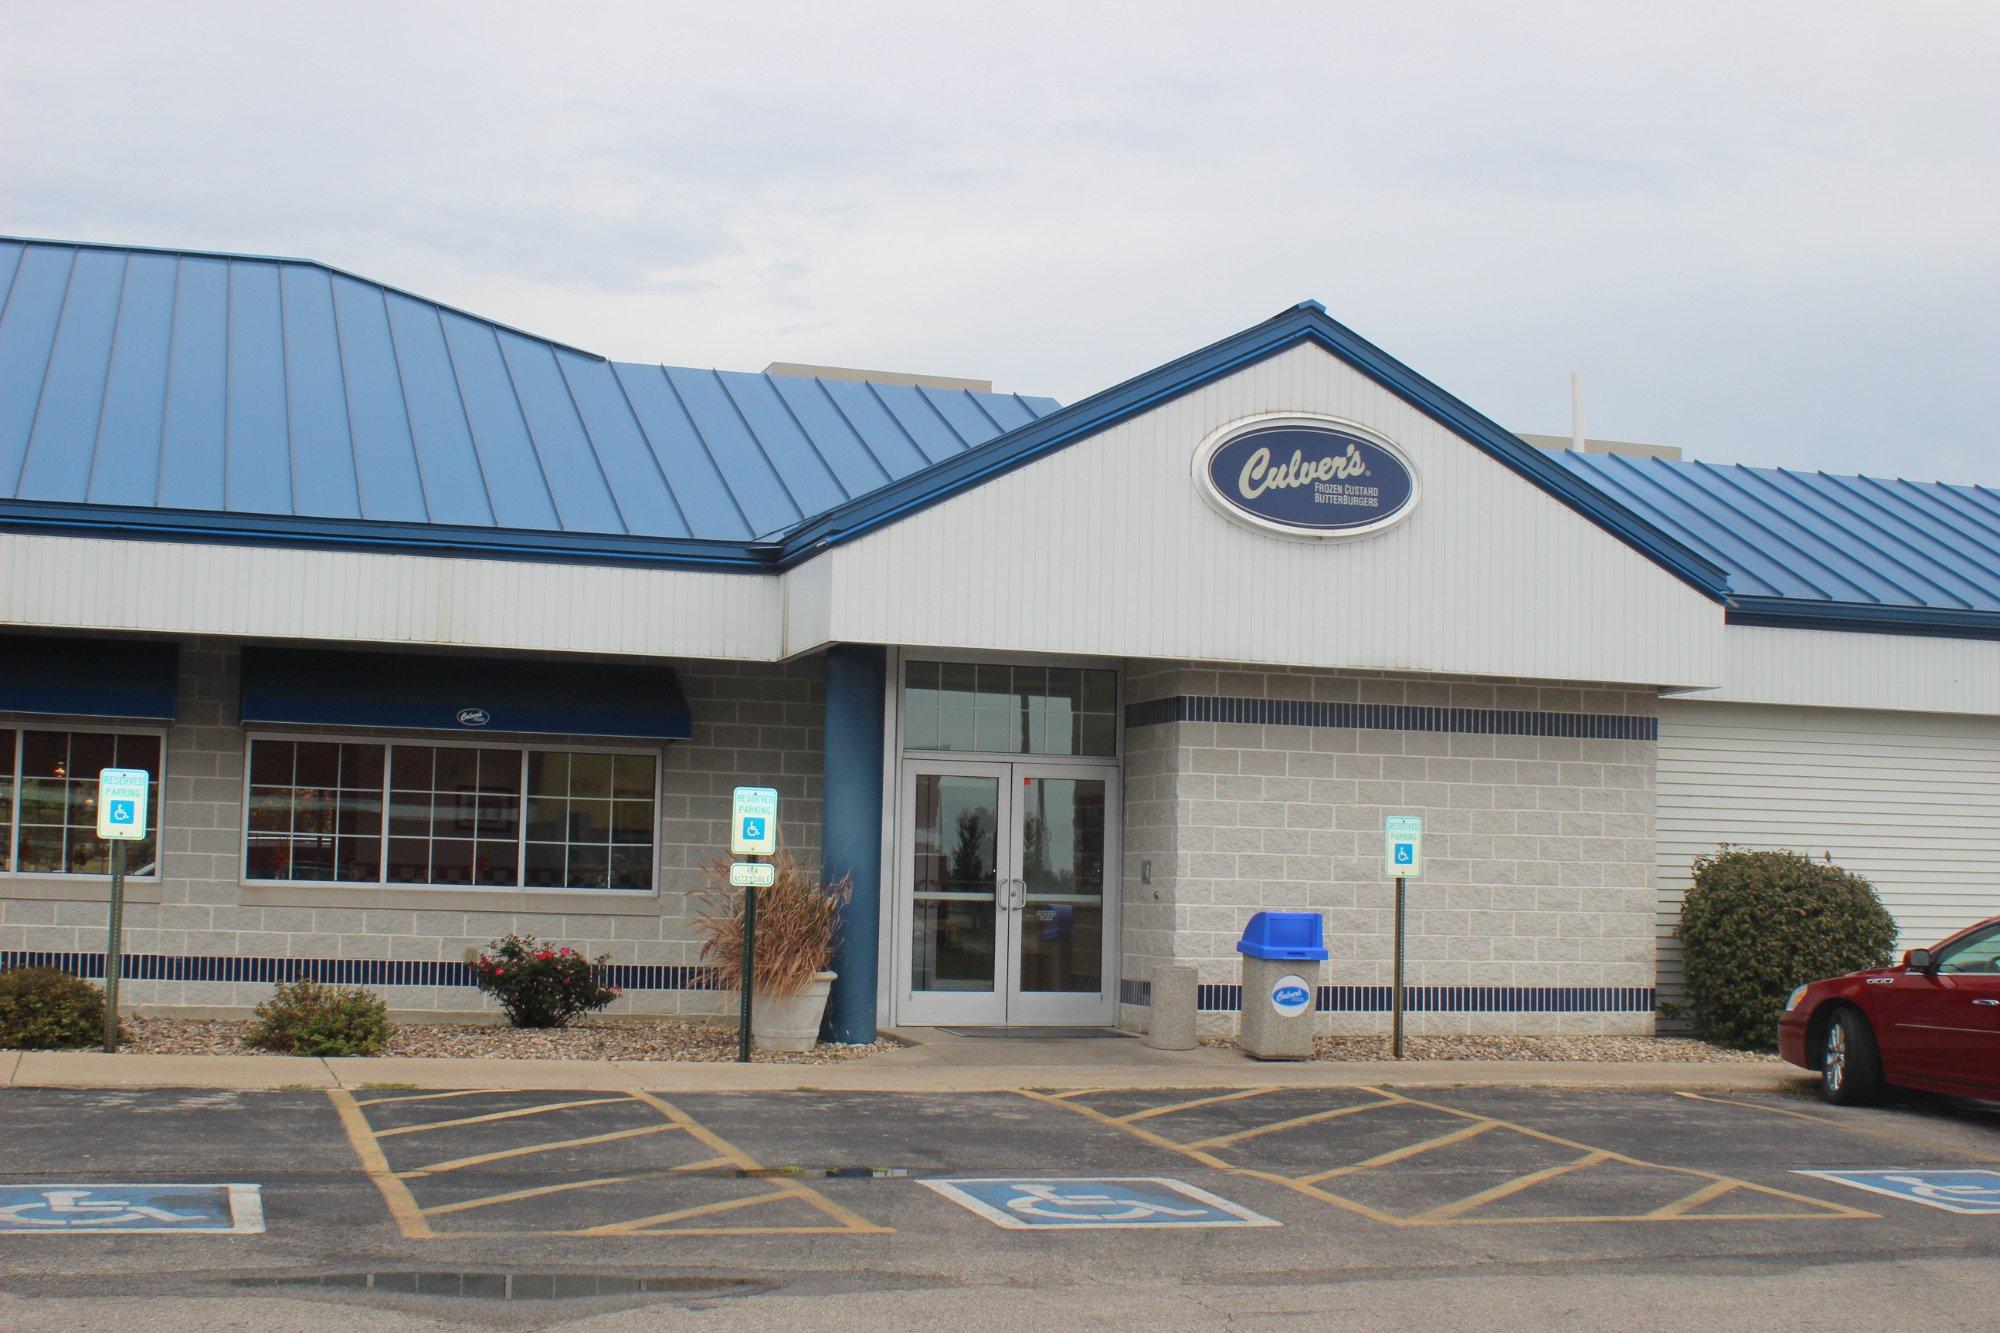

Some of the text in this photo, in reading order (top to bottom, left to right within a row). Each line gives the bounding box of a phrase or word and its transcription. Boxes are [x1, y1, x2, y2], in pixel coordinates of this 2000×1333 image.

[1238, 443, 1366, 500] Culver's
[1314, 482, 1379, 497] FROZEN CUSTARD
[1314, 492, 1379, 507] BUTTERBURGERS
[103, 775, 145, 786] RESERVED
[105, 787, 142, 798] PARKING
[737, 793, 774, 804] RESERVED
[738, 805, 772, 816] PARKING
[1391, 832, 1418, 841] PARKING
[733, 875, 770, 883] ACCESSIBLE
